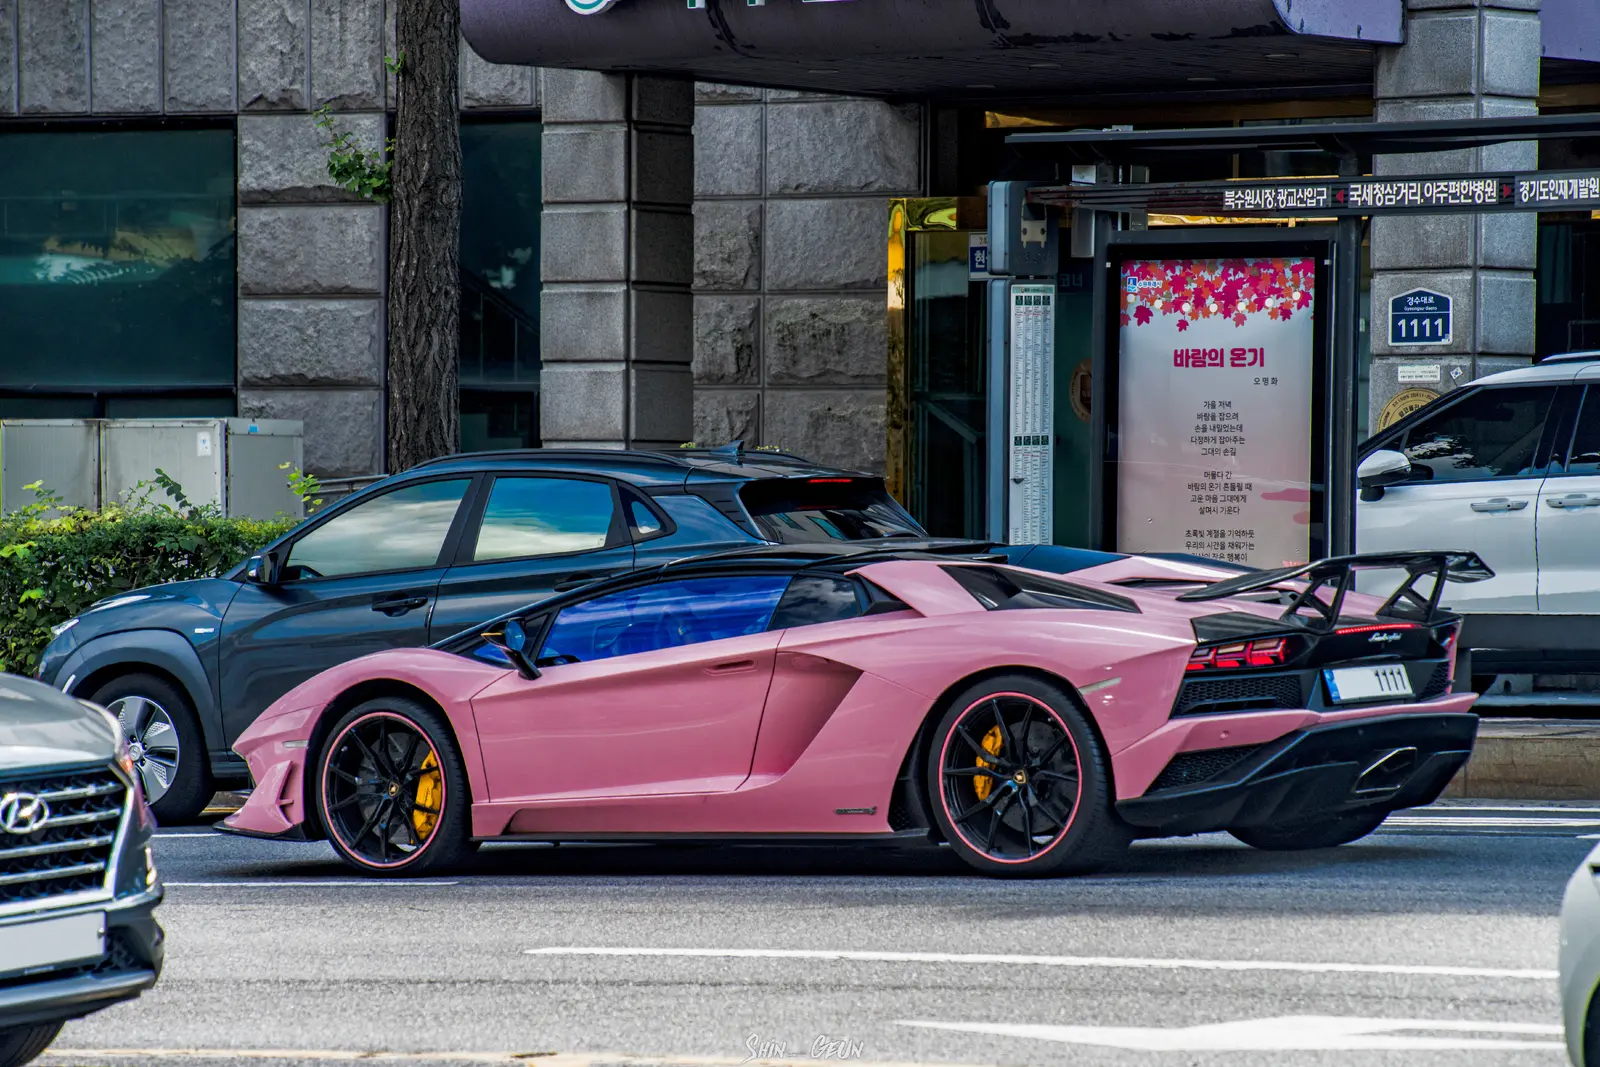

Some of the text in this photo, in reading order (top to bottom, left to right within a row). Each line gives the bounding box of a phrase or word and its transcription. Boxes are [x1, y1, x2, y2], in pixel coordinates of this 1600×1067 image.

[1519, 177, 1600, 203] 경기도인재개발원
[1406, 296, 1435, 306] 경수대로
[1397, 318, 1443, 338] 1111
[1173, 347, 1265, 368] 바람의 온기
[1203, 400, 1232, 409] 가을 저녁
[1196, 412, 1239, 421] 바람을 잡으려
[1194, 424, 1243, 433] 손을 내밀었는데
[1190, 436, 1246, 445] 다정하게 잡아주는
[1200, 448, 1237, 457] 그대의 손길
[1203, 471, 1232, 480] 머물다 간
[1187, 482, 1207, 491] 바람의
[1208, 482, 1222, 491] 온기
[1245, 482, 1253, 491] 때
[1190, 494, 1247, 503] 고운 마음 그대에게
[1185, 529, 1255, 538] 초록빛 계절을 기억하듯
[1185, 541, 1205, 550] 우리의
[1206, 541, 1226, 550] 시간을
[1226, 552, 1248, 562] 행복이
[1374, 667, 1407, 692] 1111
